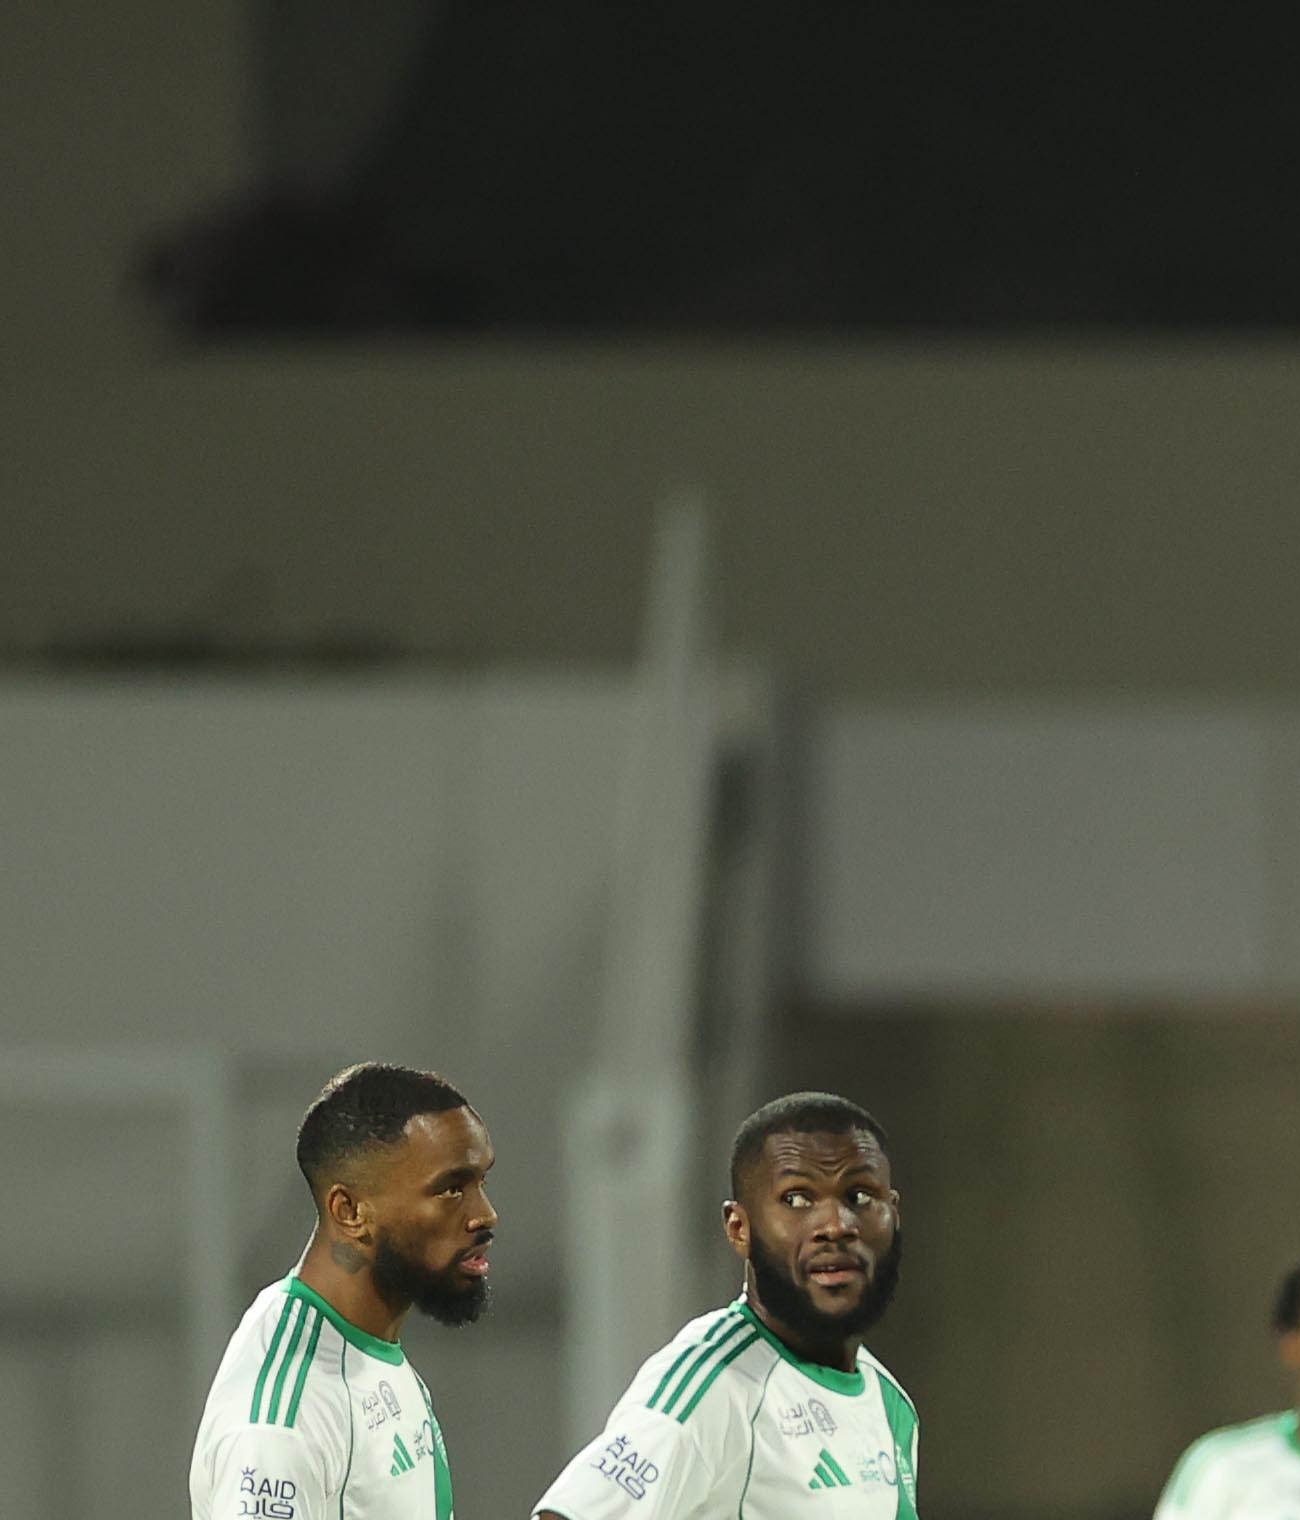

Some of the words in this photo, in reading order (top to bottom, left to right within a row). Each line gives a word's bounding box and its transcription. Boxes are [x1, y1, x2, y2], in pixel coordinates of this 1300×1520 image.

[606, 1440, 659, 1483] QAID
[240, 1476, 296, 1500] QAID
[238, 1498, 294, 1519] قايد
